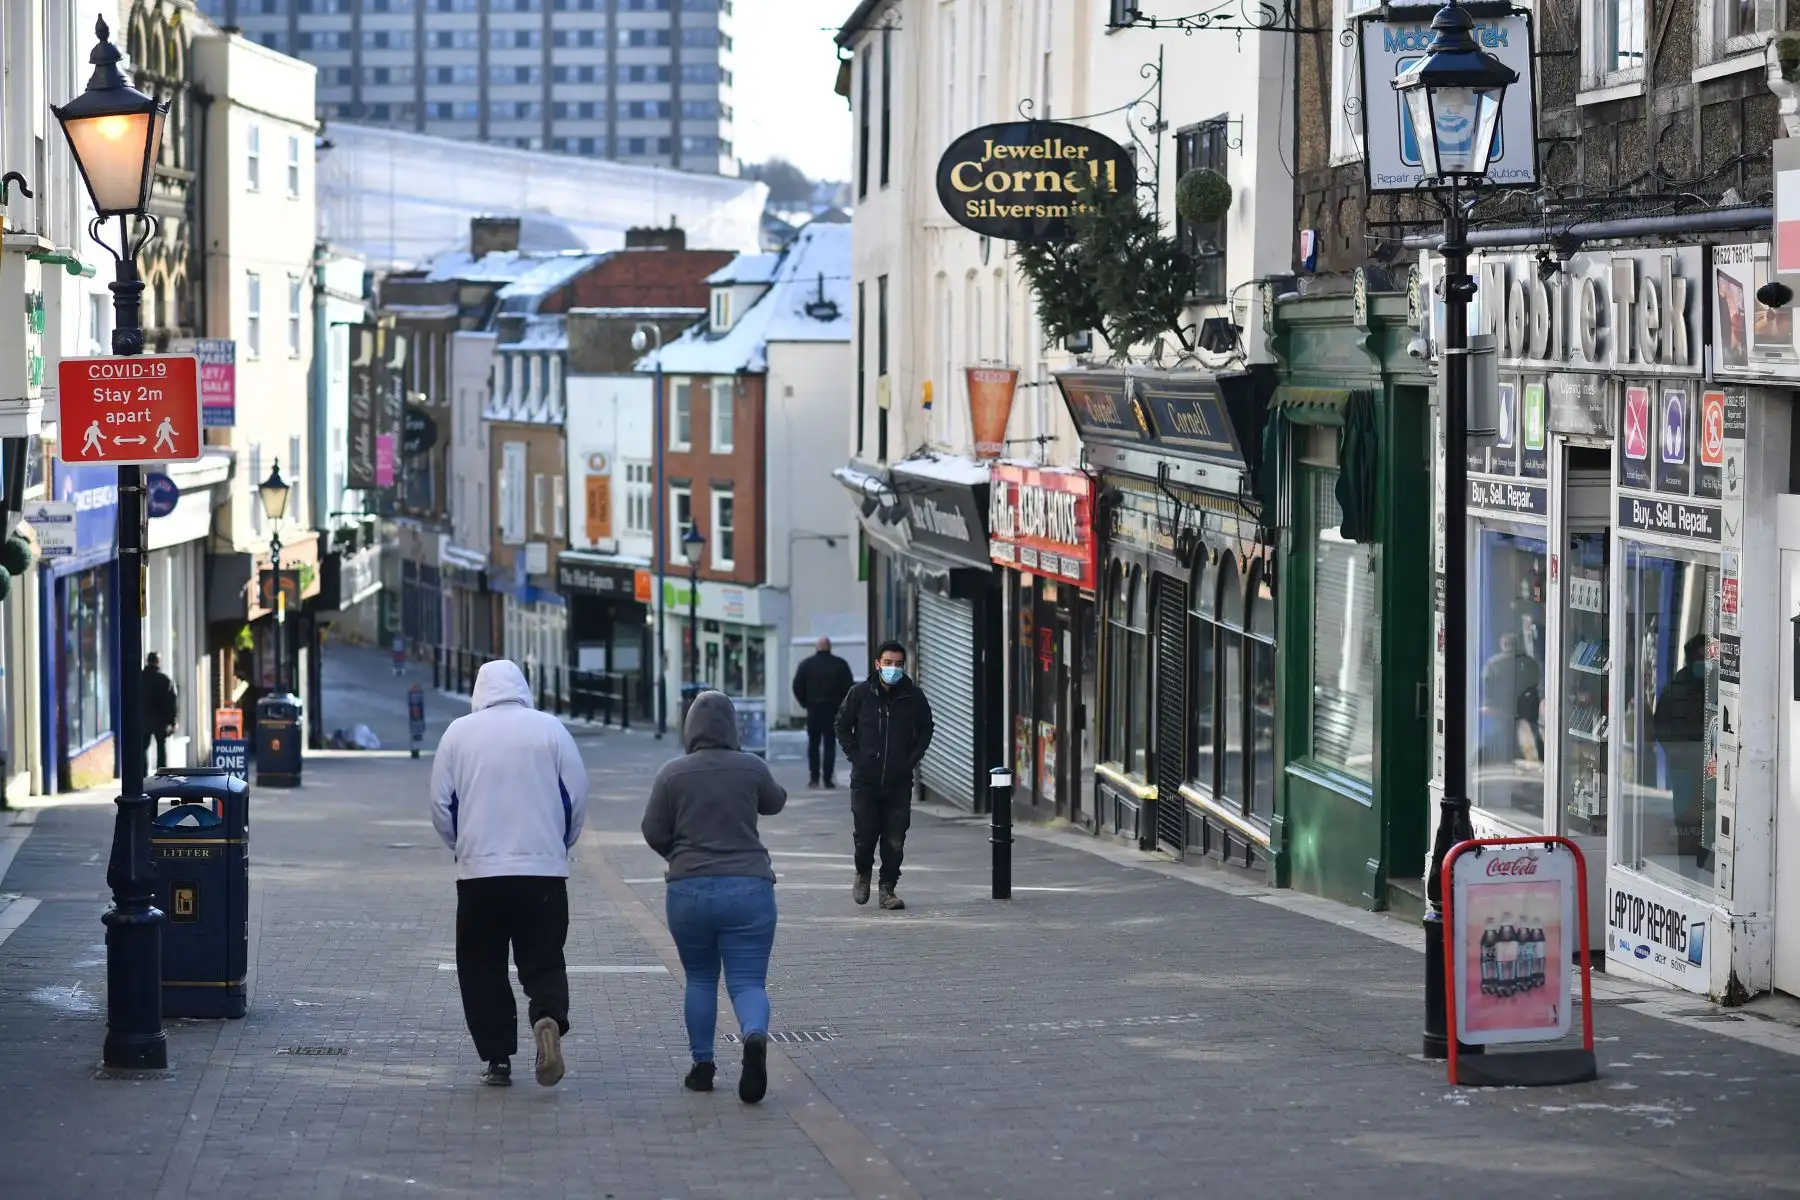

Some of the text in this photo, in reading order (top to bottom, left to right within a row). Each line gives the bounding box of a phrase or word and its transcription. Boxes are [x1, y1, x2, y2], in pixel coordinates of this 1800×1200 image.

[1384, 27, 1436, 53] Mob
[981, 138, 1089, 163] Jeweller
[1377, 173, 1410, 185] Repair
[966, 199, 1098, 218] Silversmit
[1713, 247, 1731, 265] 01622
[1611, 255, 1688, 365] Tek
[88, 363, 167, 379] COVID-19
[93, 386, 163, 404] Stay 2m
[105, 407, 152, 425] apart
[1167, 400, 1211, 436] Cornell
[1018, 485, 1046, 538] KEBAB
[1047, 490, 1078, 545] HOUSE
[216, 745, 245, 753] FOLLOW
[216, 755, 245, 769] ONE
[226, 771, 245, 780] AY
[163, 849, 209, 857] LITTER
[1609, 887, 1687, 953] LAPTOP REPAIRS
[1670, 959, 1687, 974] SONY
